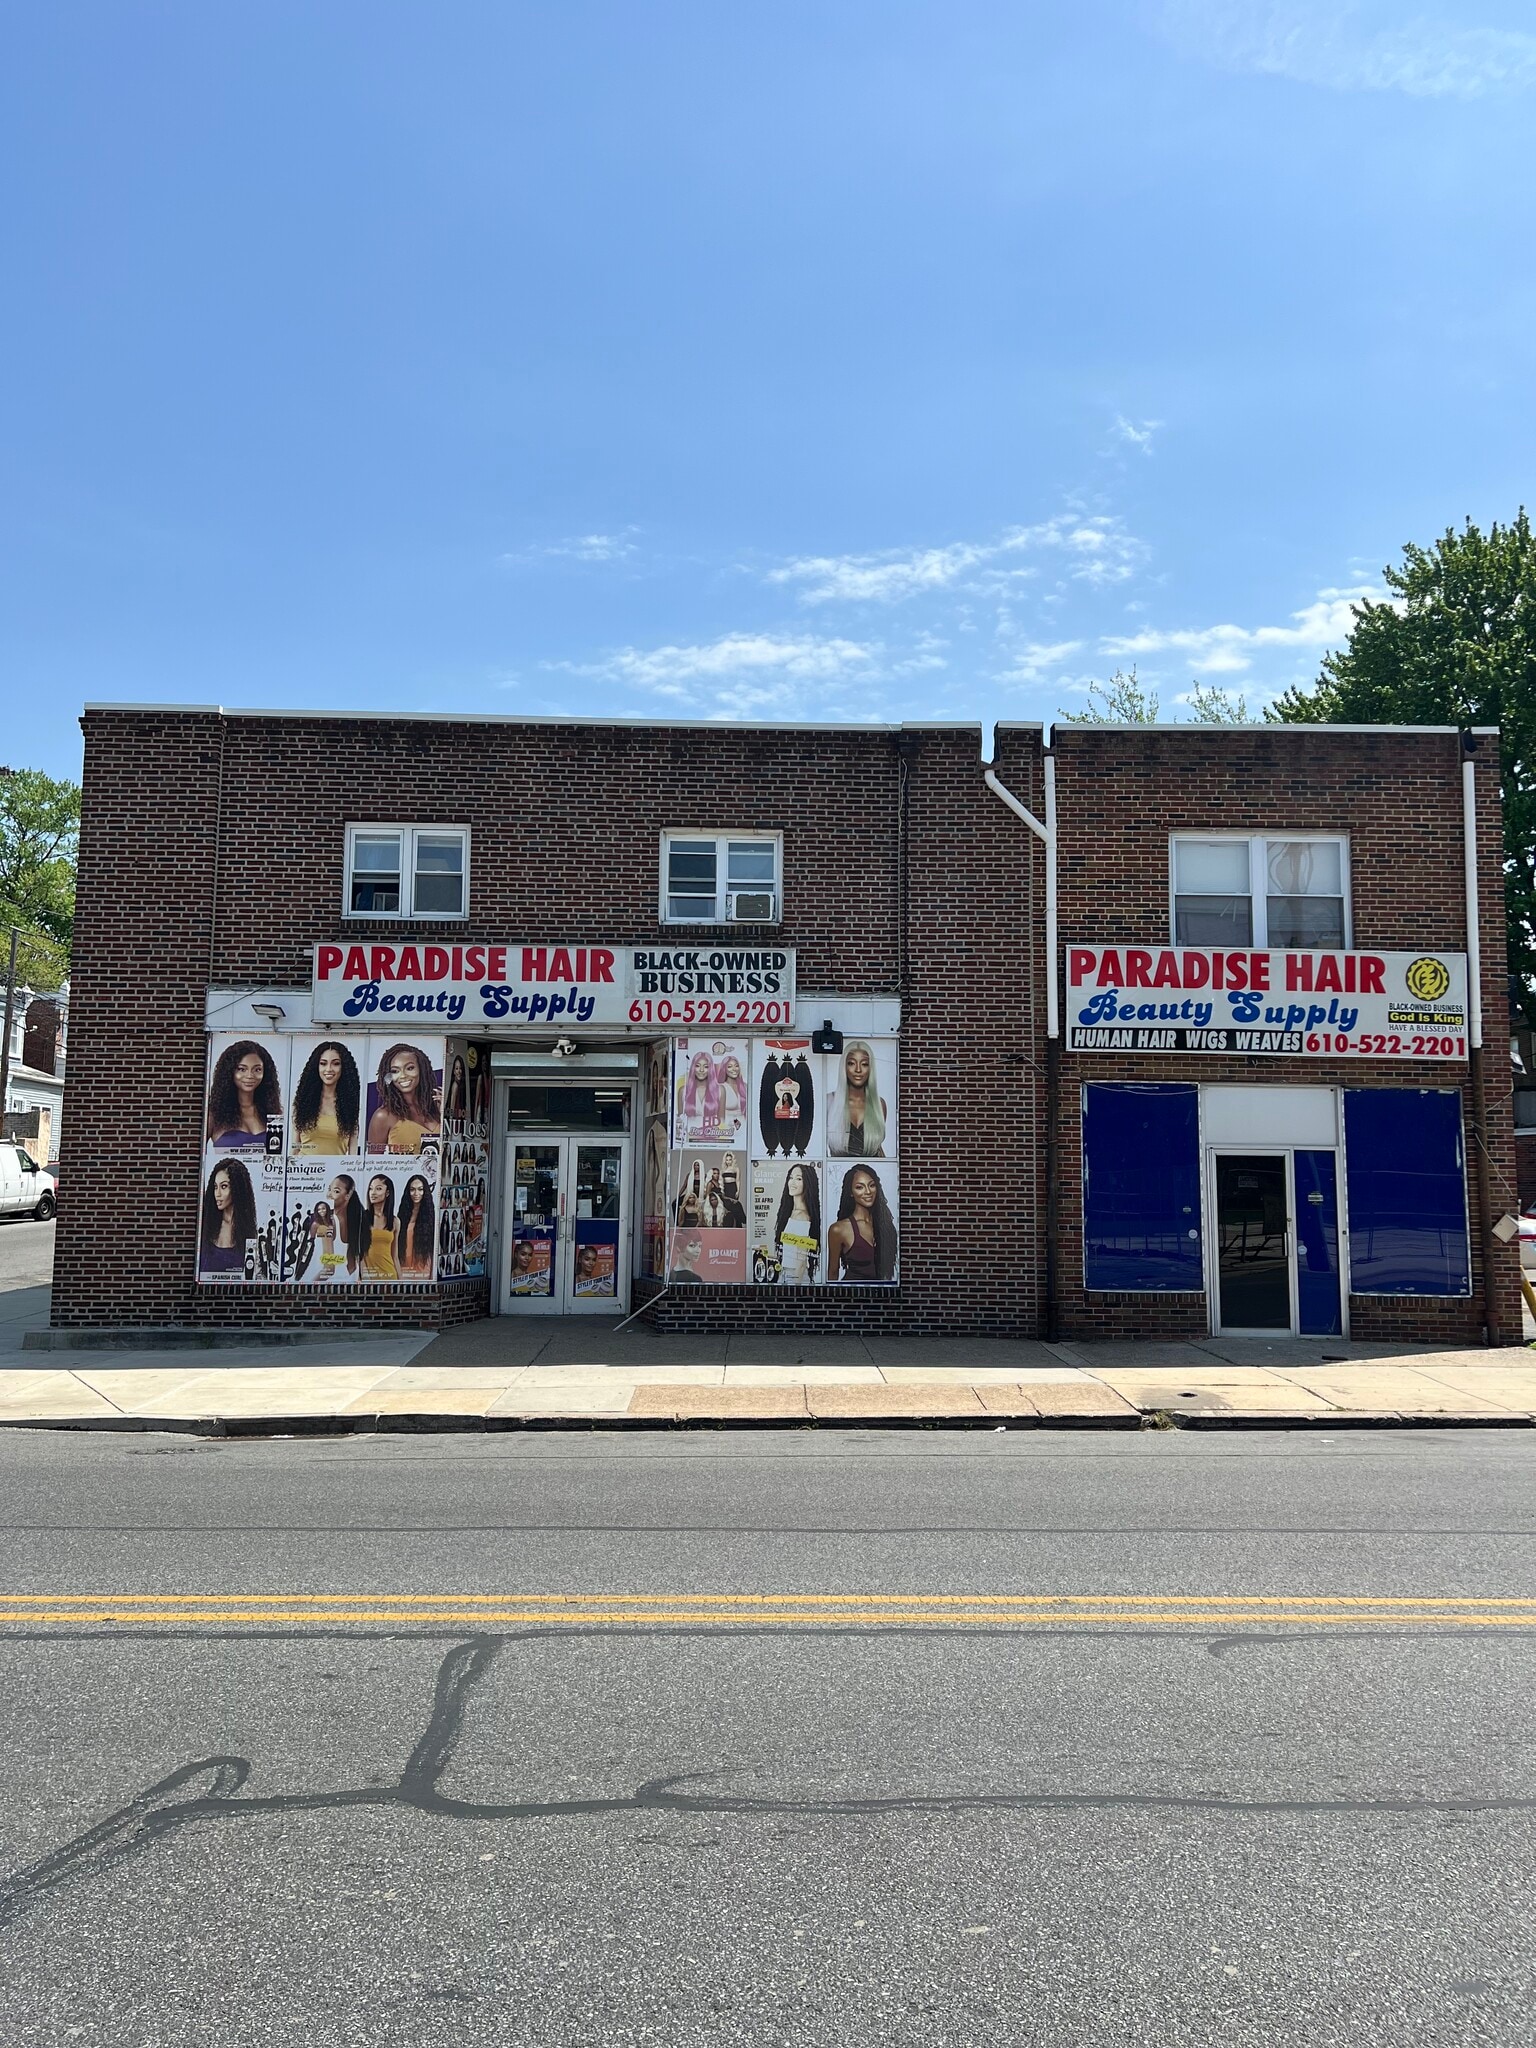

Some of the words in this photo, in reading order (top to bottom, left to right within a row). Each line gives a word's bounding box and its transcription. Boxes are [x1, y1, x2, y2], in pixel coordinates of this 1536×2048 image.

[318, 946, 507, 981] PARADISE
[521, 947, 615, 982] HAIR
[634, 952, 787, 970] BLACK-OWNED
[1071, 950, 1270, 991] PARADISE
[1286, 954, 1386, 993] HAIR
[639, 972, 780, 993] BUSINESS
[343, 978, 466, 1020] Beauty
[480, 984, 595, 1021] Supply
[1389, 1003, 1432, 1011] BLACK-OWNED
[1433, 1004, 1463, 1012] BUSINESS
[628, 1000, 790, 1023] 610-522-2201
[1078, 989, 1213, 1027] Beauty
[1227, 991, 1359, 1032] Supply
[1390, 1012, 1415, 1022] God
[1418, 1013, 1430, 1022] Is
[1434, 1014, 1463, 1025] King
[1389, 1024, 1407, 1032] HAVE
[1416, 1025, 1447, 1033] BLESSED
[1074, 1029, 1133, 1048] HUMAN
[1137, 1030, 1177, 1048] HAIR
[1186, 1030, 1227, 1049] WIGS
[1236, 1031, 1301, 1051] WEAVES
[1306, 1033, 1465, 1056] 610-522-2201
[703, 1116, 721, 1127] HD
[709, 1249, 720, 1259] RED
[720, 1249, 739, 1259] CARPET
